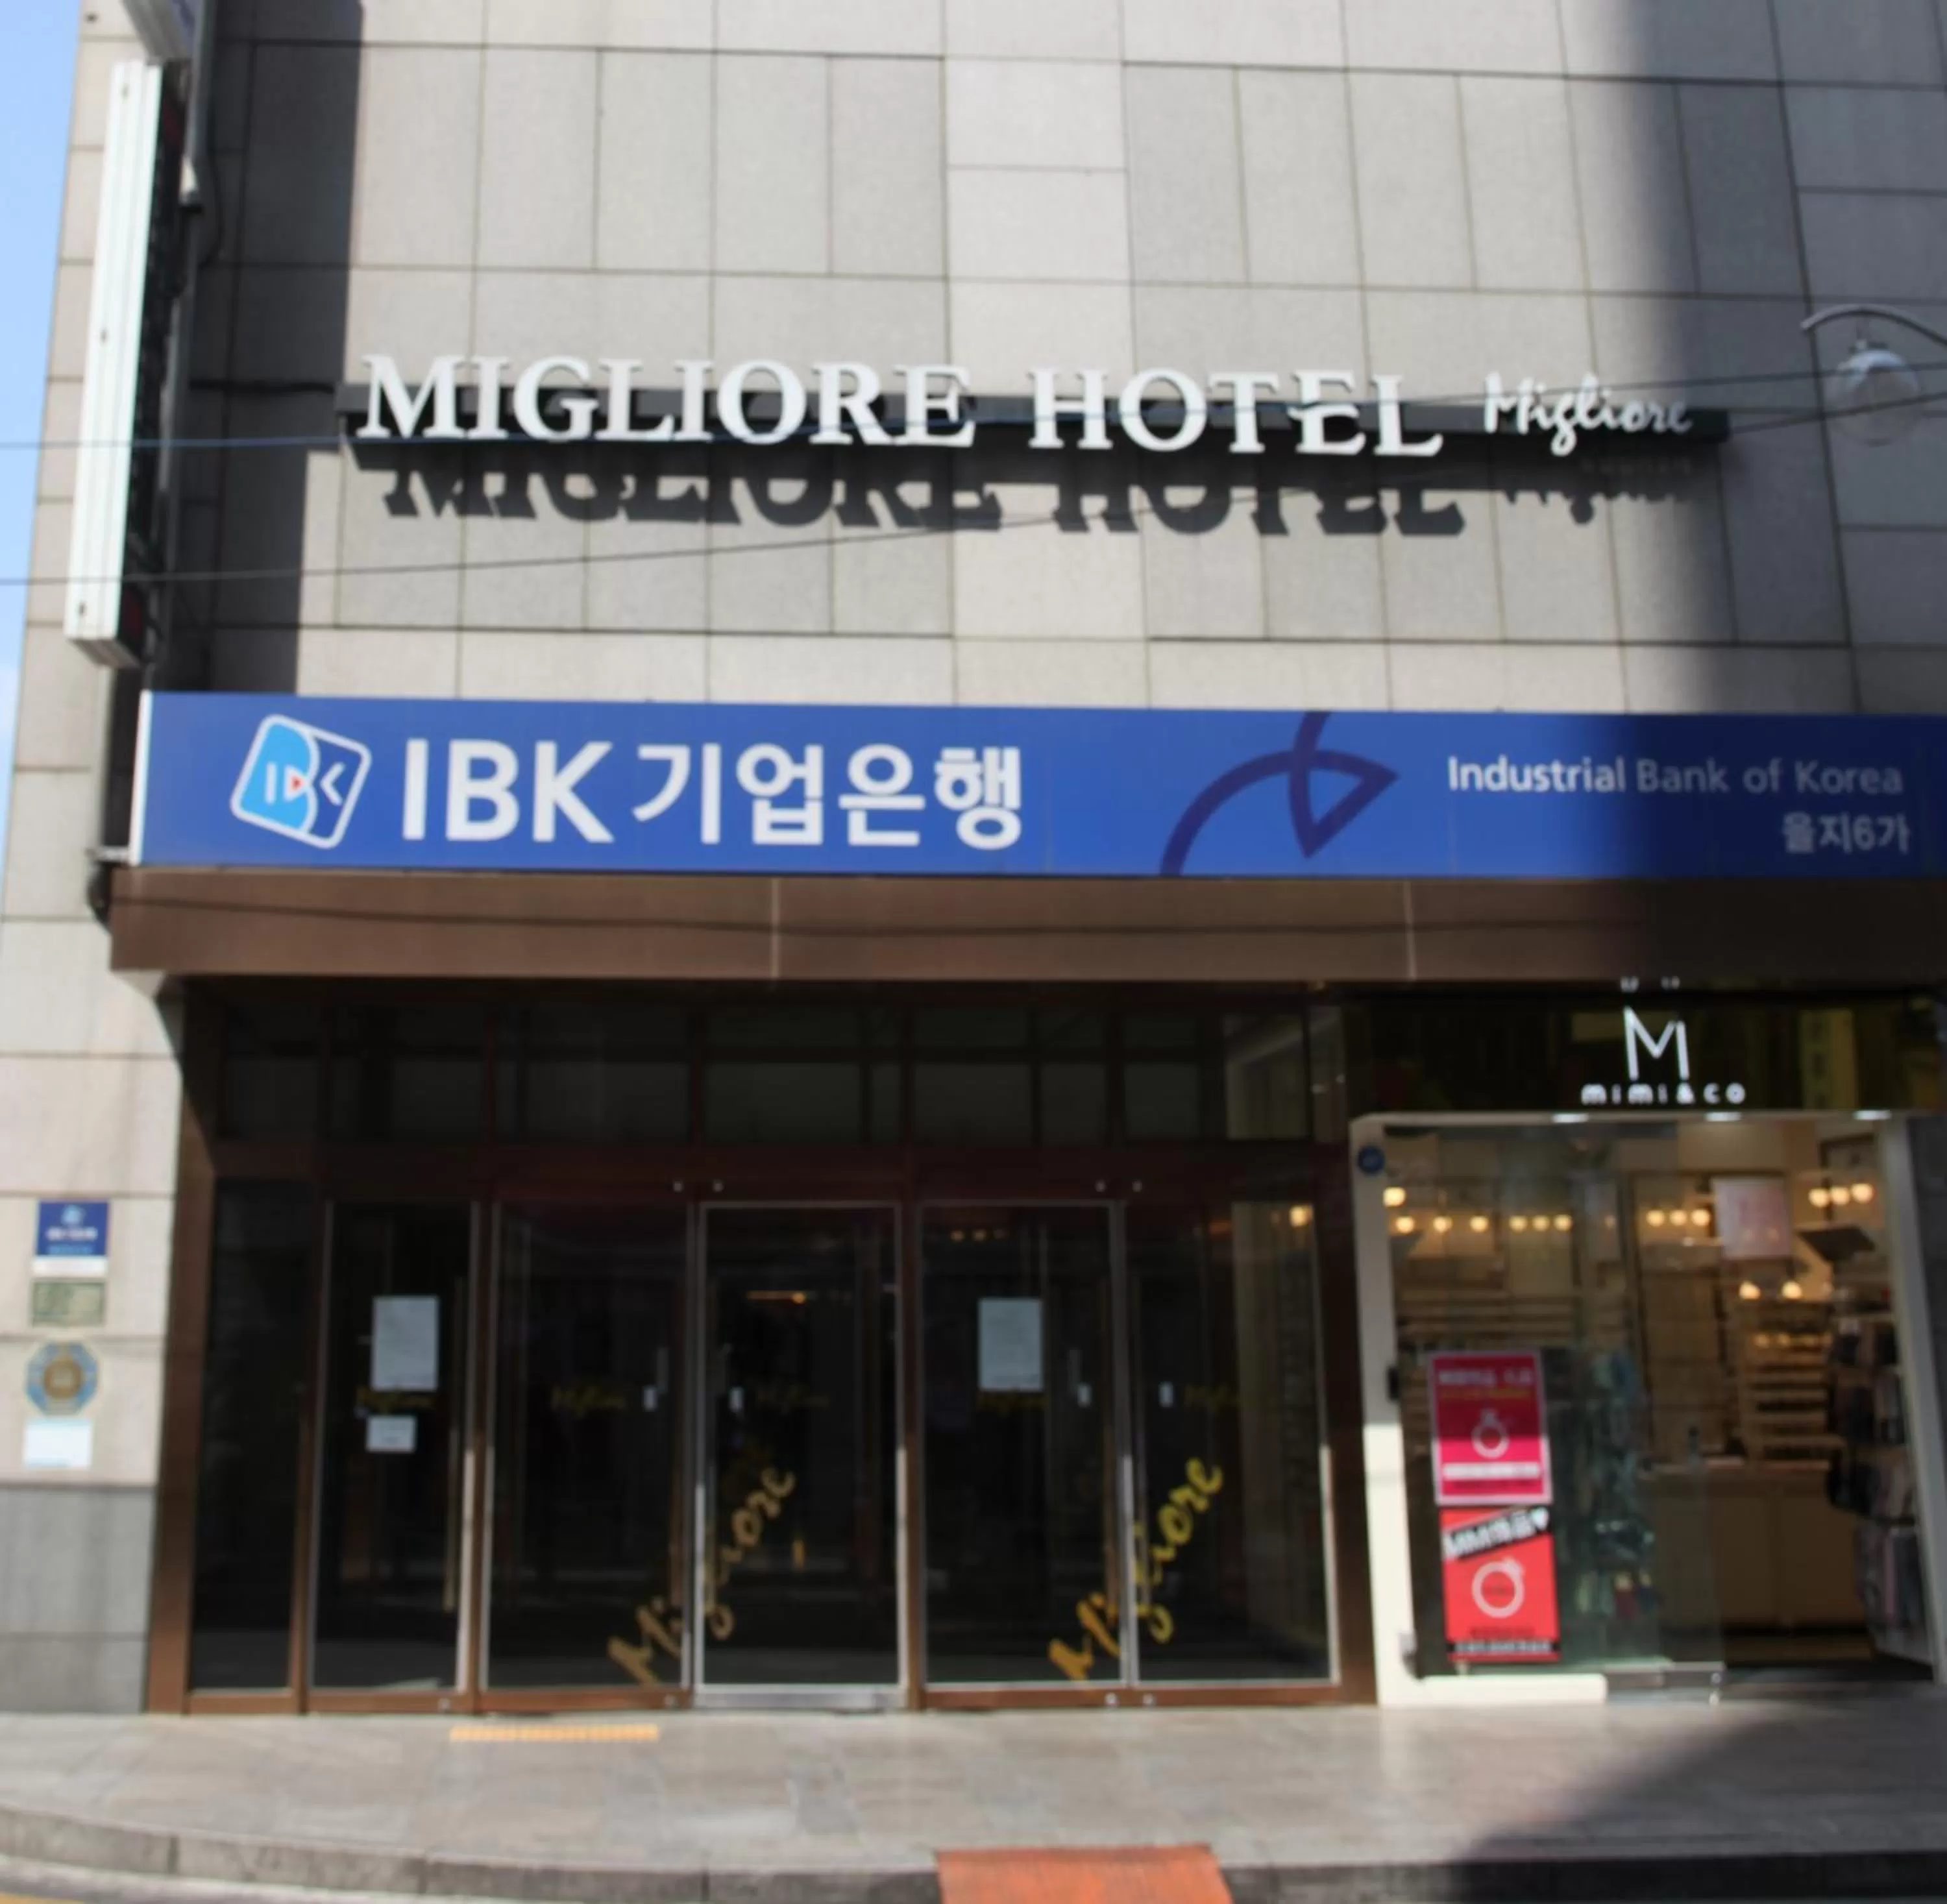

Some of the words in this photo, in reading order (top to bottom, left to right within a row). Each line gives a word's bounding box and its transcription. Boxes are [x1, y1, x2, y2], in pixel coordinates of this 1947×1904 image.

[356, 355, 976, 448] MIGLIORE
[1029, 367, 1443, 457] HOTEL
[1484, 371, 1693, 457] Migliore
[402, 738, 615, 843] IBK
[632, 742, 1022, 850] 기업은행
[1447, 754, 1626, 793] Industrial
[1634, 758, 1730, 794] Bank
[1743, 758, 1783, 794] of
[1794, 761, 1904, 795] Korea
[1782, 811, 1911, 854] 을지6가
[1622, 1005, 1690, 1081] M
